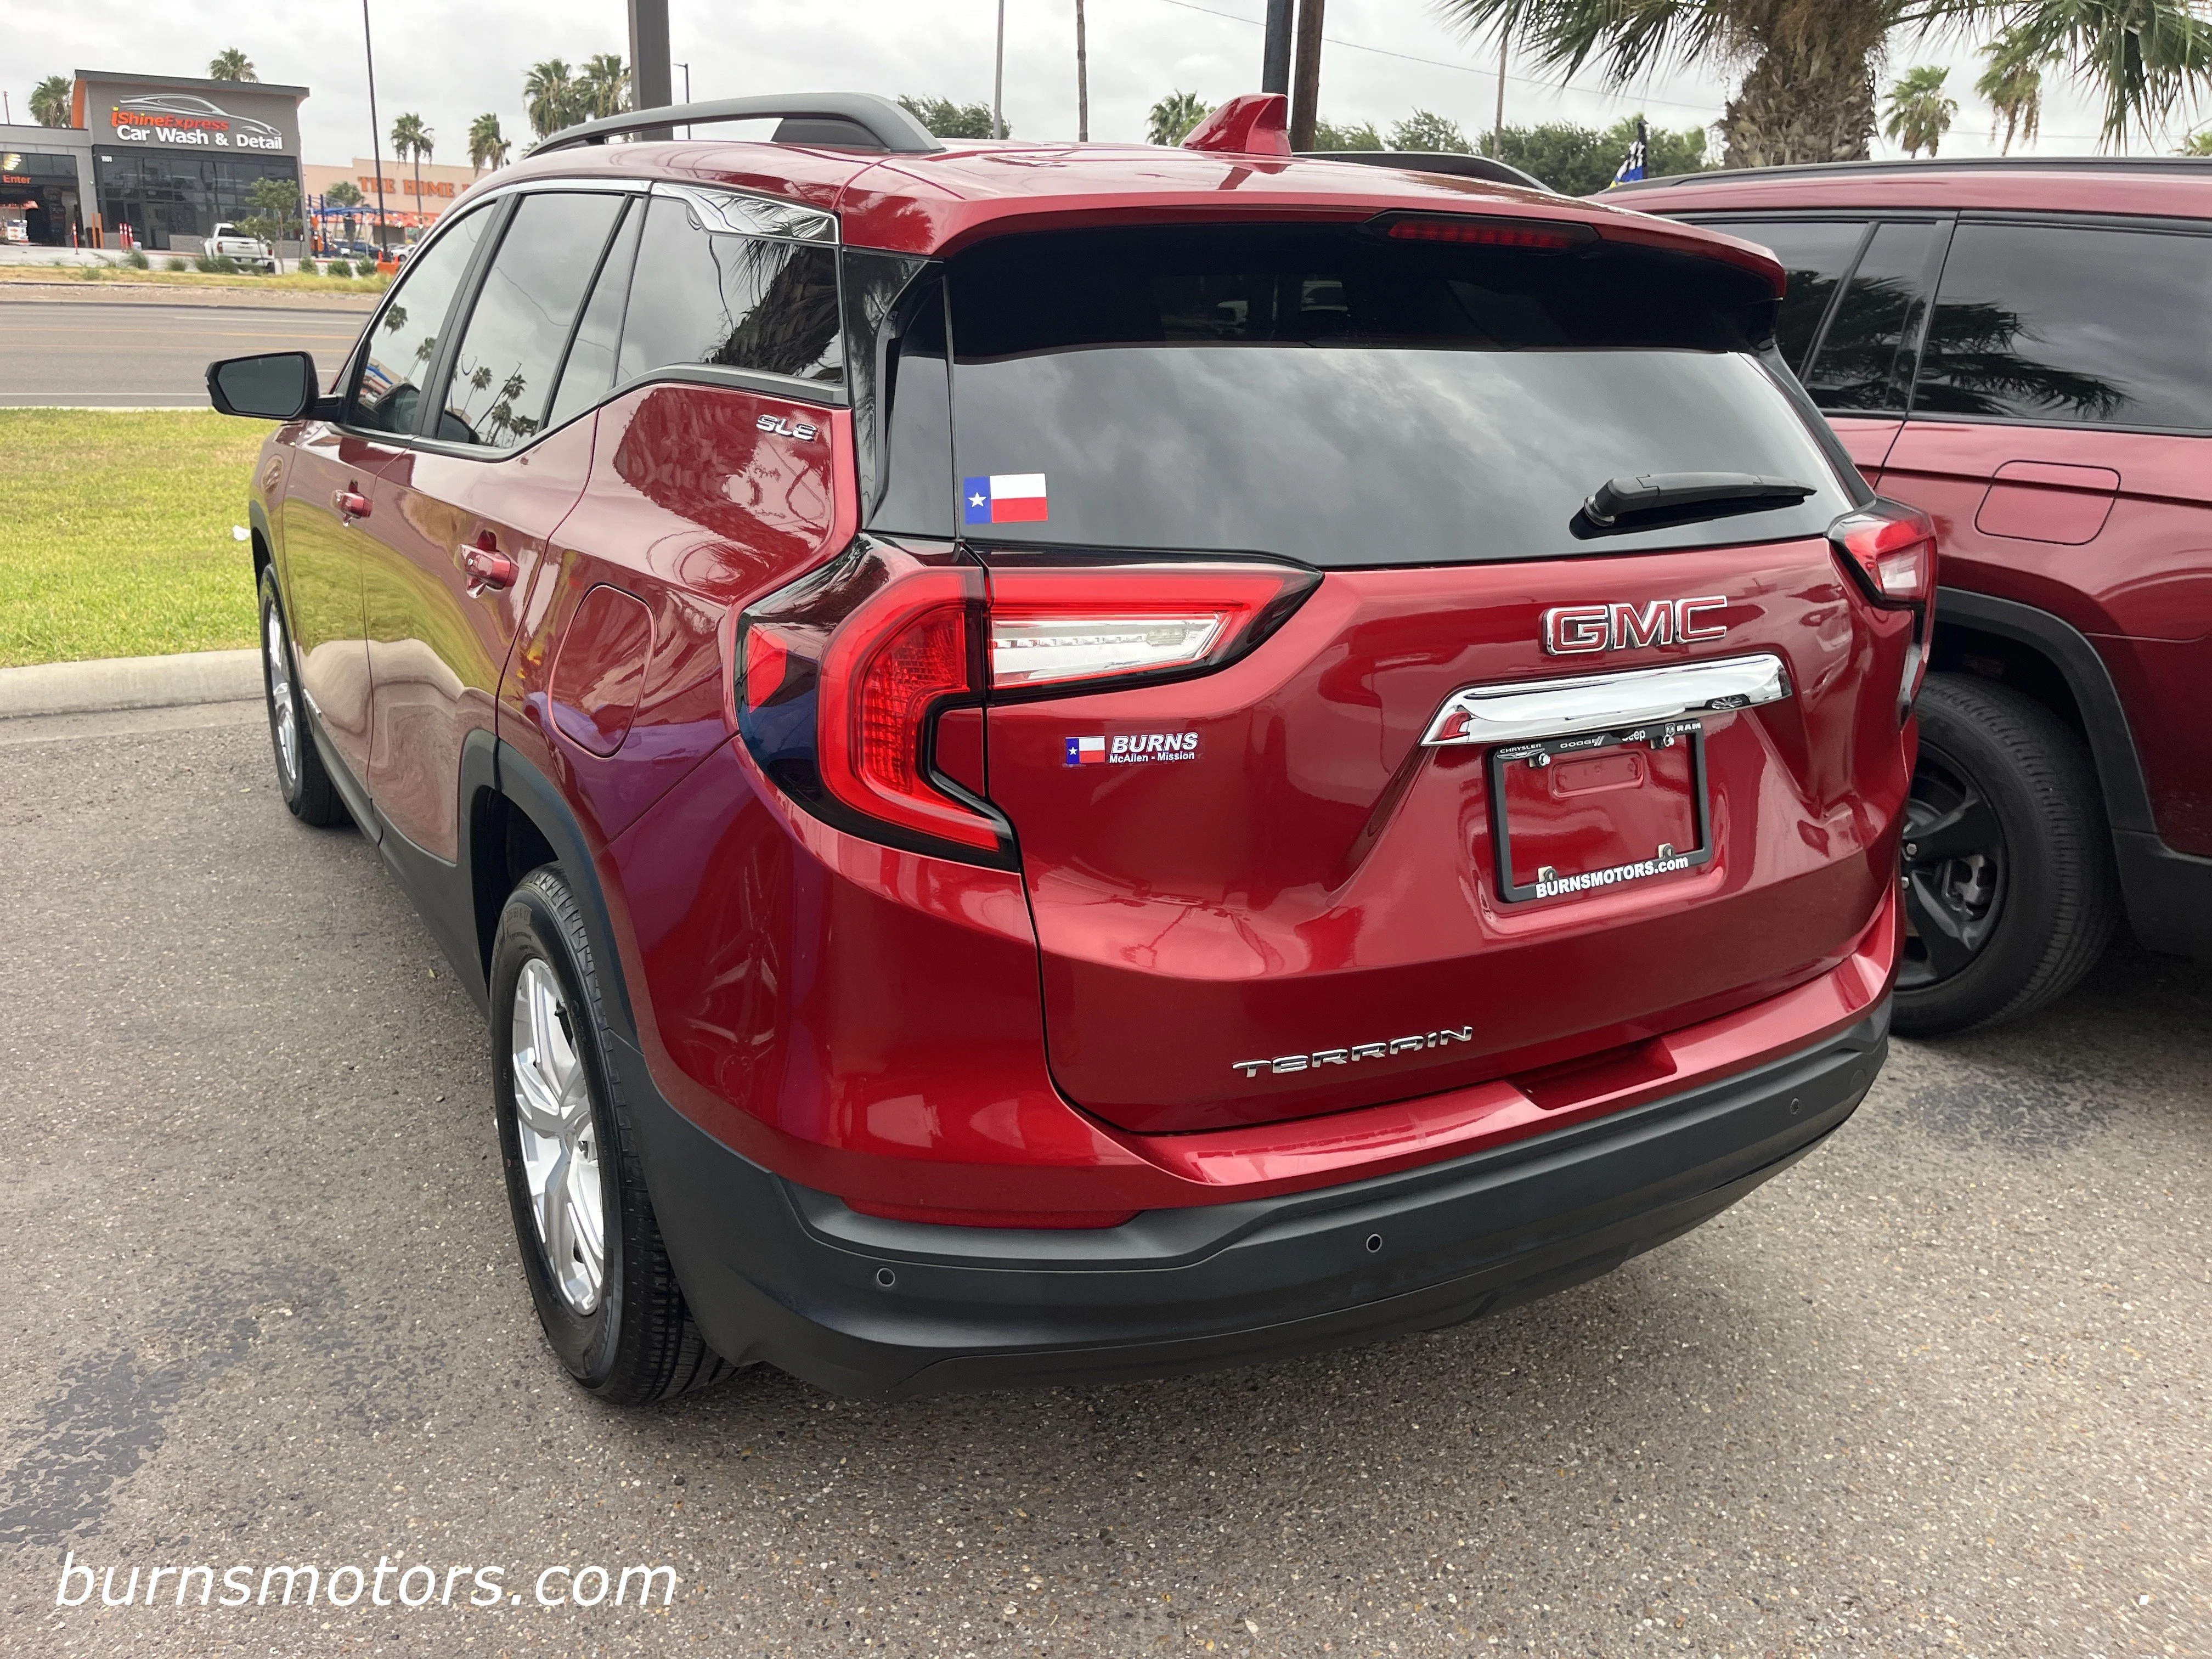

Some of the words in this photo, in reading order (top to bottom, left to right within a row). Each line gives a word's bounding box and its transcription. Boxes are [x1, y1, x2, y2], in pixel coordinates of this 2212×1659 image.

[111, 106, 229, 131] iShineExpress
[116, 125, 150, 141] Car
[155, 127, 210, 145] Wash
[215, 133, 229, 146] &
[236, 134, 283, 150] Detail
[3, 175, 31, 184] Enter
[756, 414, 817, 442] SLE
[1544, 595, 1728, 655] GMC
[1677, 722, 1701, 732] RAM
[1111, 732, 1199, 753] BURNS
[1499, 743, 1542, 754] CHRYSLER
[1109, 753, 1148, 763] McAllen
[1157, 752, 1195, 761] Mission
[1536, 856, 1689, 899] BURNSMOTORS.com
[1232, 1025, 1473, 1078] TERRAIN
